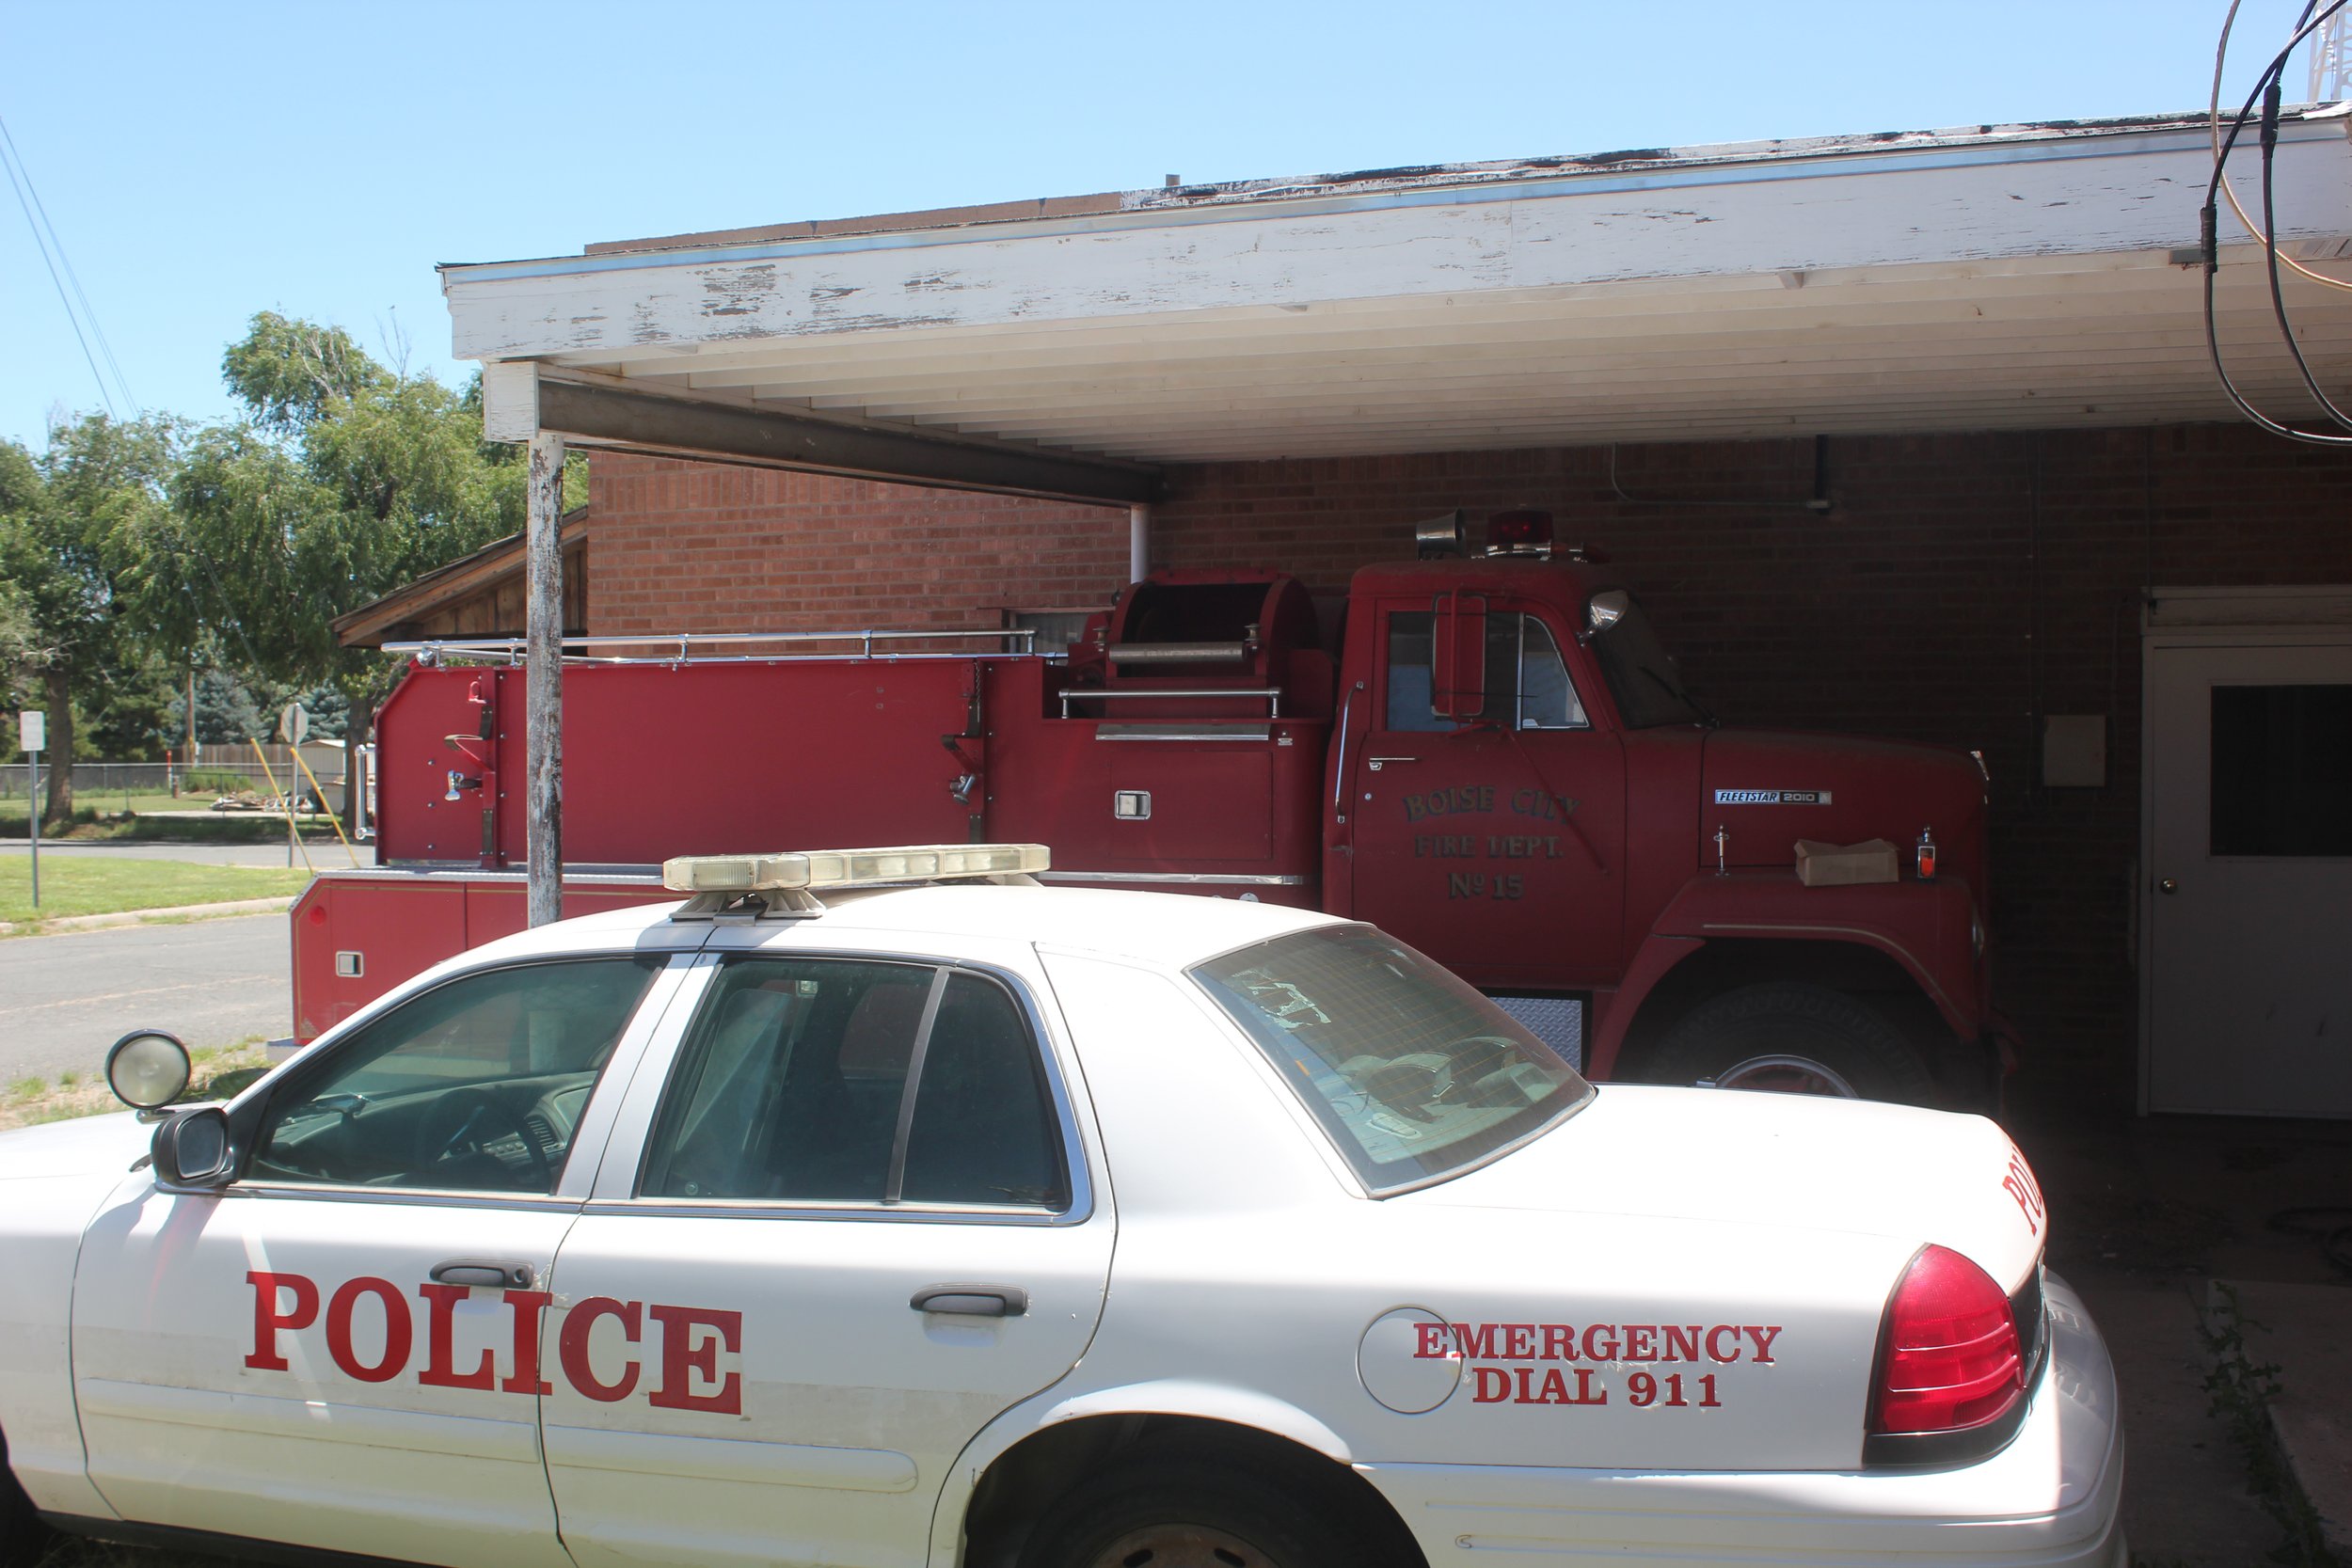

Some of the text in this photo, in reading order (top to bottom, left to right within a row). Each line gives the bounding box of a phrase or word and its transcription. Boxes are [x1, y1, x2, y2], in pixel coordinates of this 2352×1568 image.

[1403, 784, 1582, 827] BOISE CITY
[1719, 791, 1816, 802] FLEETSTAR 2010
[1414, 834, 1565, 859] FIRE DEPT.
[1491, 872, 1526, 901] 15
[244, 1270, 742, 1416] POLICE
[1412, 1322, 1783, 1364] EMERGENCY
[1471, 1367, 1723, 1408] DIAL 911
